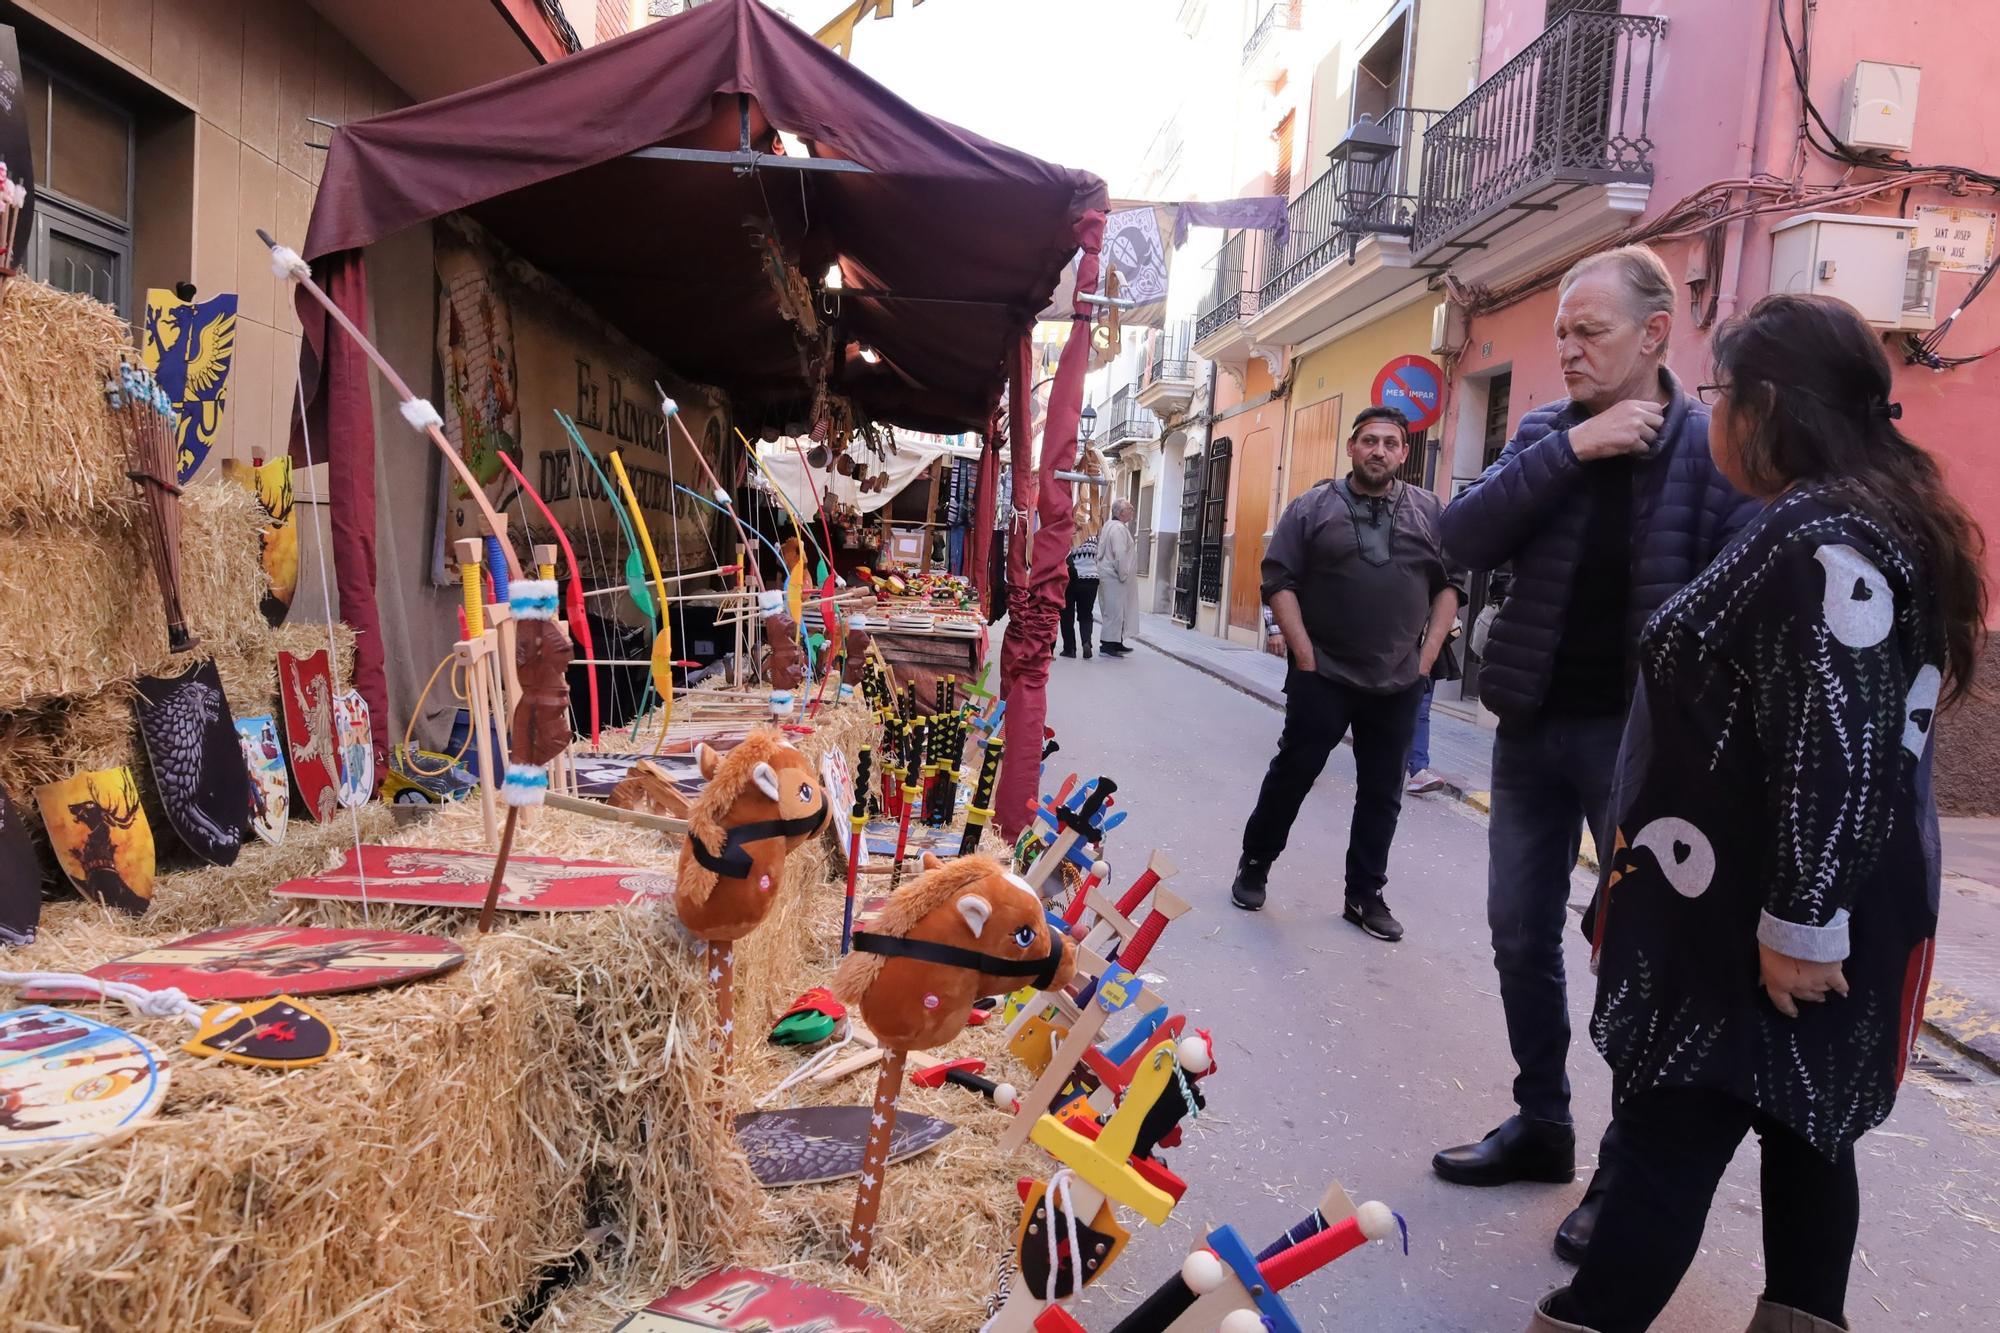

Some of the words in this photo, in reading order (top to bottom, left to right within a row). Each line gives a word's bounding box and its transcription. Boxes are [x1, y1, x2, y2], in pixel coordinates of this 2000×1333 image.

[1934, 228, 1949, 239] SANT
[1954, 230, 1972, 241] JOSEP
[575, 359, 603, 432] EL
[1386, 389, 1405, 397] MES
[1409, 390, 1434, 399] IMPAR
[540, 448, 571, 504] DE
[577, 449, 612, 502] LOS
